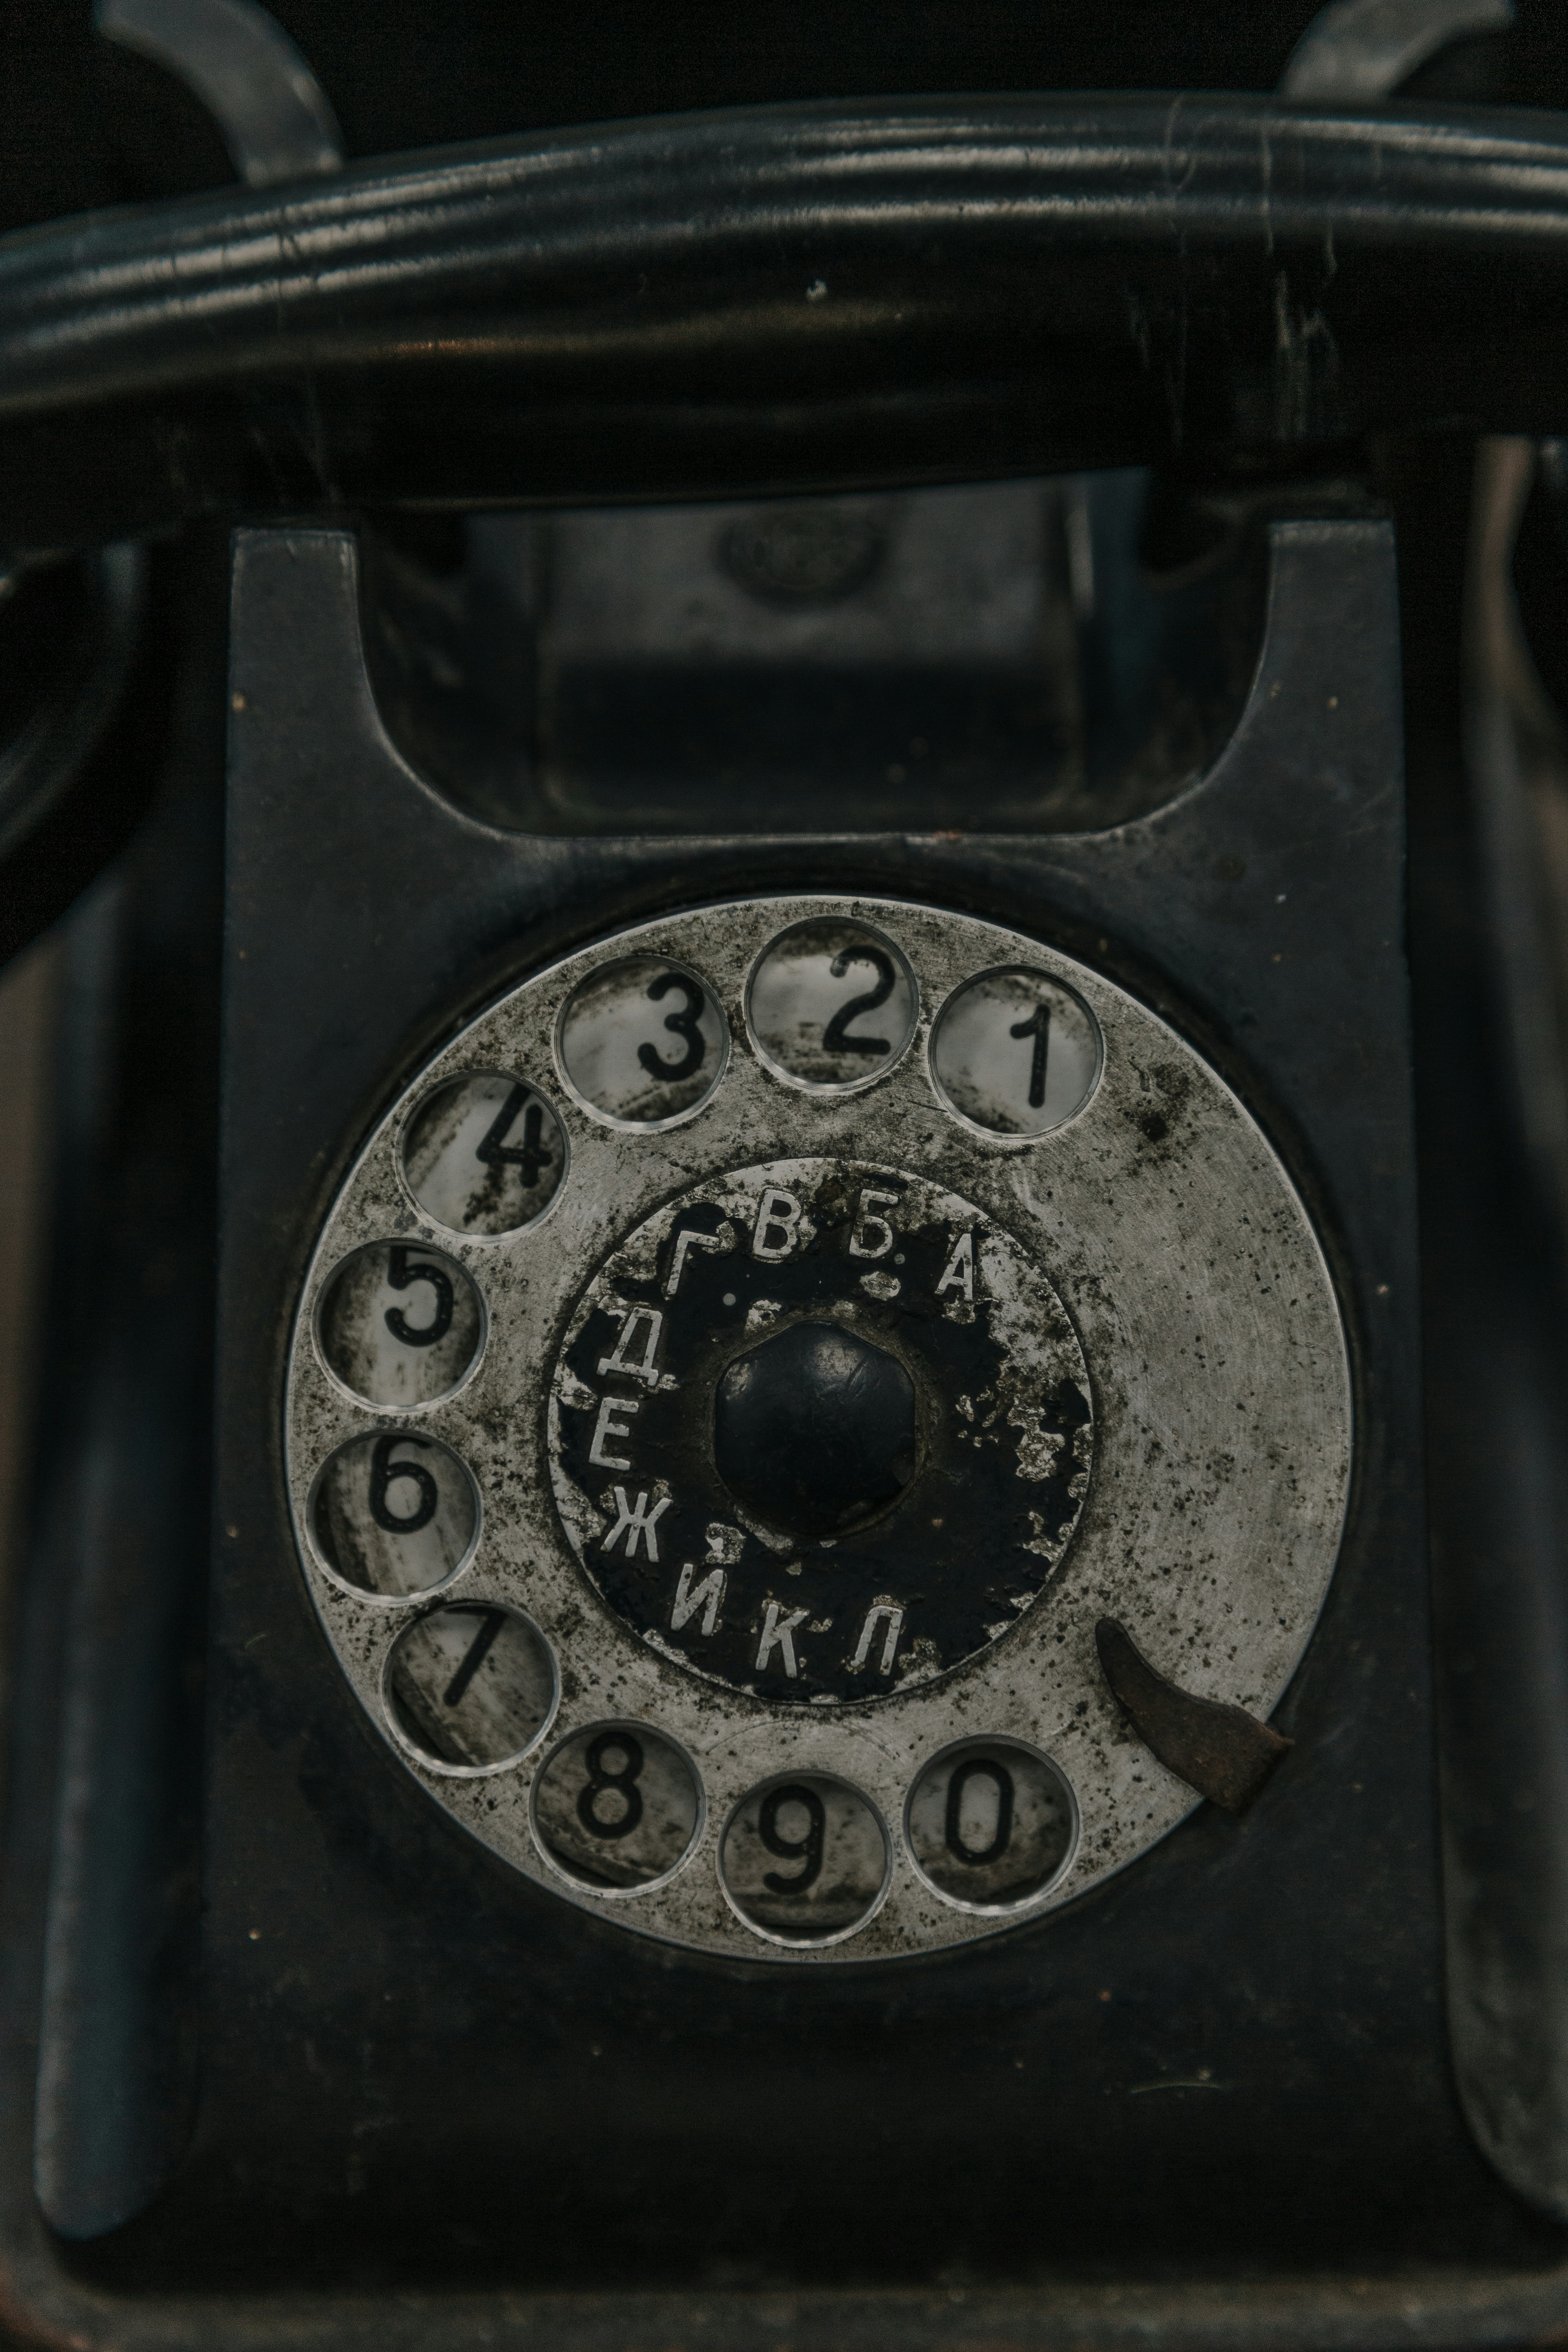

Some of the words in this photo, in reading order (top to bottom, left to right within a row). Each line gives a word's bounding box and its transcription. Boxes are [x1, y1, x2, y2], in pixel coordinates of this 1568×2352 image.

[638, 971, 705, 1082] 3
[823, 945, 895, 1054] 2
[1010, 1004, 1049, 1108] 1
[476, 1083, 554, 1188] 4
[666, 1229, 720, 1297] Г
[752, 1189, 802, 1259] В
[849, 1189, 900, 1259] Б
[385, 1246, 454, 1347] 5
[935, 1233, 974, 1302] А
[597, 1307, 663, 1387] Д
[589, 1397, 639, 1471] Е
[369, 1435, 438, 1535] 6
[601, 1486, 673, 1563] Ж
[670, 1564, 726, 1636] И
[443, 1605, 507, 1707] 7
[755, 1604, 811, 1678] К
[850, 1605, 903, 1676] Л
[577, 1731, 644, 1839] 8
[758, 1784, 826, 1896] 9
